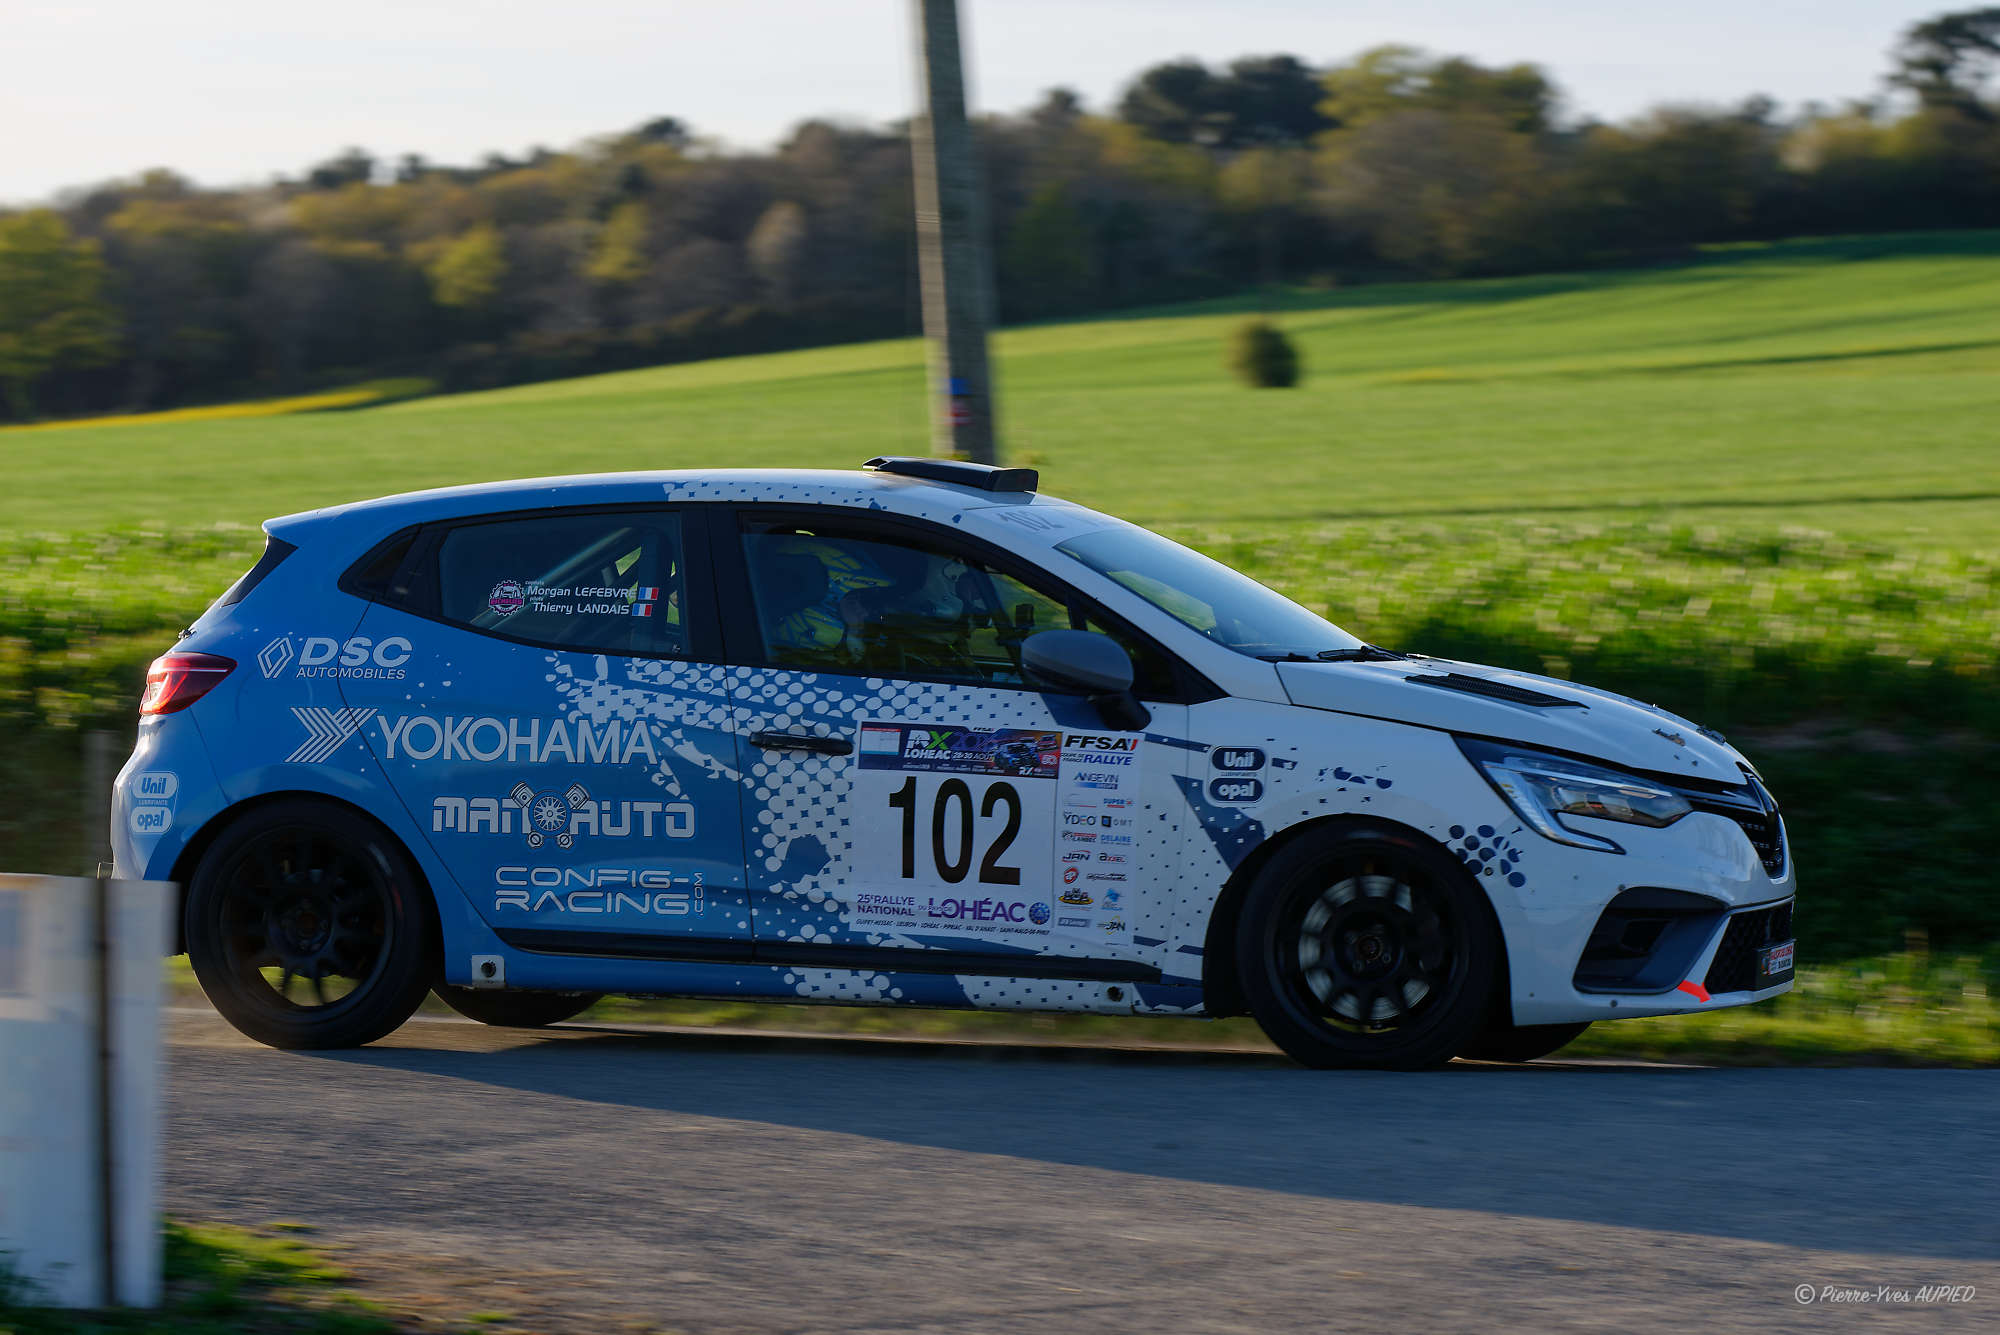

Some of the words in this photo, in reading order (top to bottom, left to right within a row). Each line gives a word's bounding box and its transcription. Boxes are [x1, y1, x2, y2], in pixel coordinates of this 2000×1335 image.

[527, 586, 571, 599] Morgan
[575, 587, 637, 599] LEFEBVRE
[533, 602, 573, 614] Thierry
[577, 604, 630, 615] LANDAIS
[299, 637, 413, 667] DSC
[296, 667, 406, 680] AUTOMOBILES
[376, 715, 657, 764] YOKOHAMA
[1064, 735, 1129, 751] FFSA
[904, 748, 951, 760] LOHEAC
[1083, 754, 1134, 766] RALLYE
[1224, 752, 1255, 767] Unil
[141, 777, 167, 794] Unil
[1218, 781, 1255, 800] opal
[137, 810, 165, 830] opal
[889, 776, 1022, 885] 102
[495, 890, 690, 915] RACING
[873, 895, 915, 906] RALLYE
[857, 904, 915, 917] NATIONAL
[928, 897, 1026, 923] LOHÉAC
